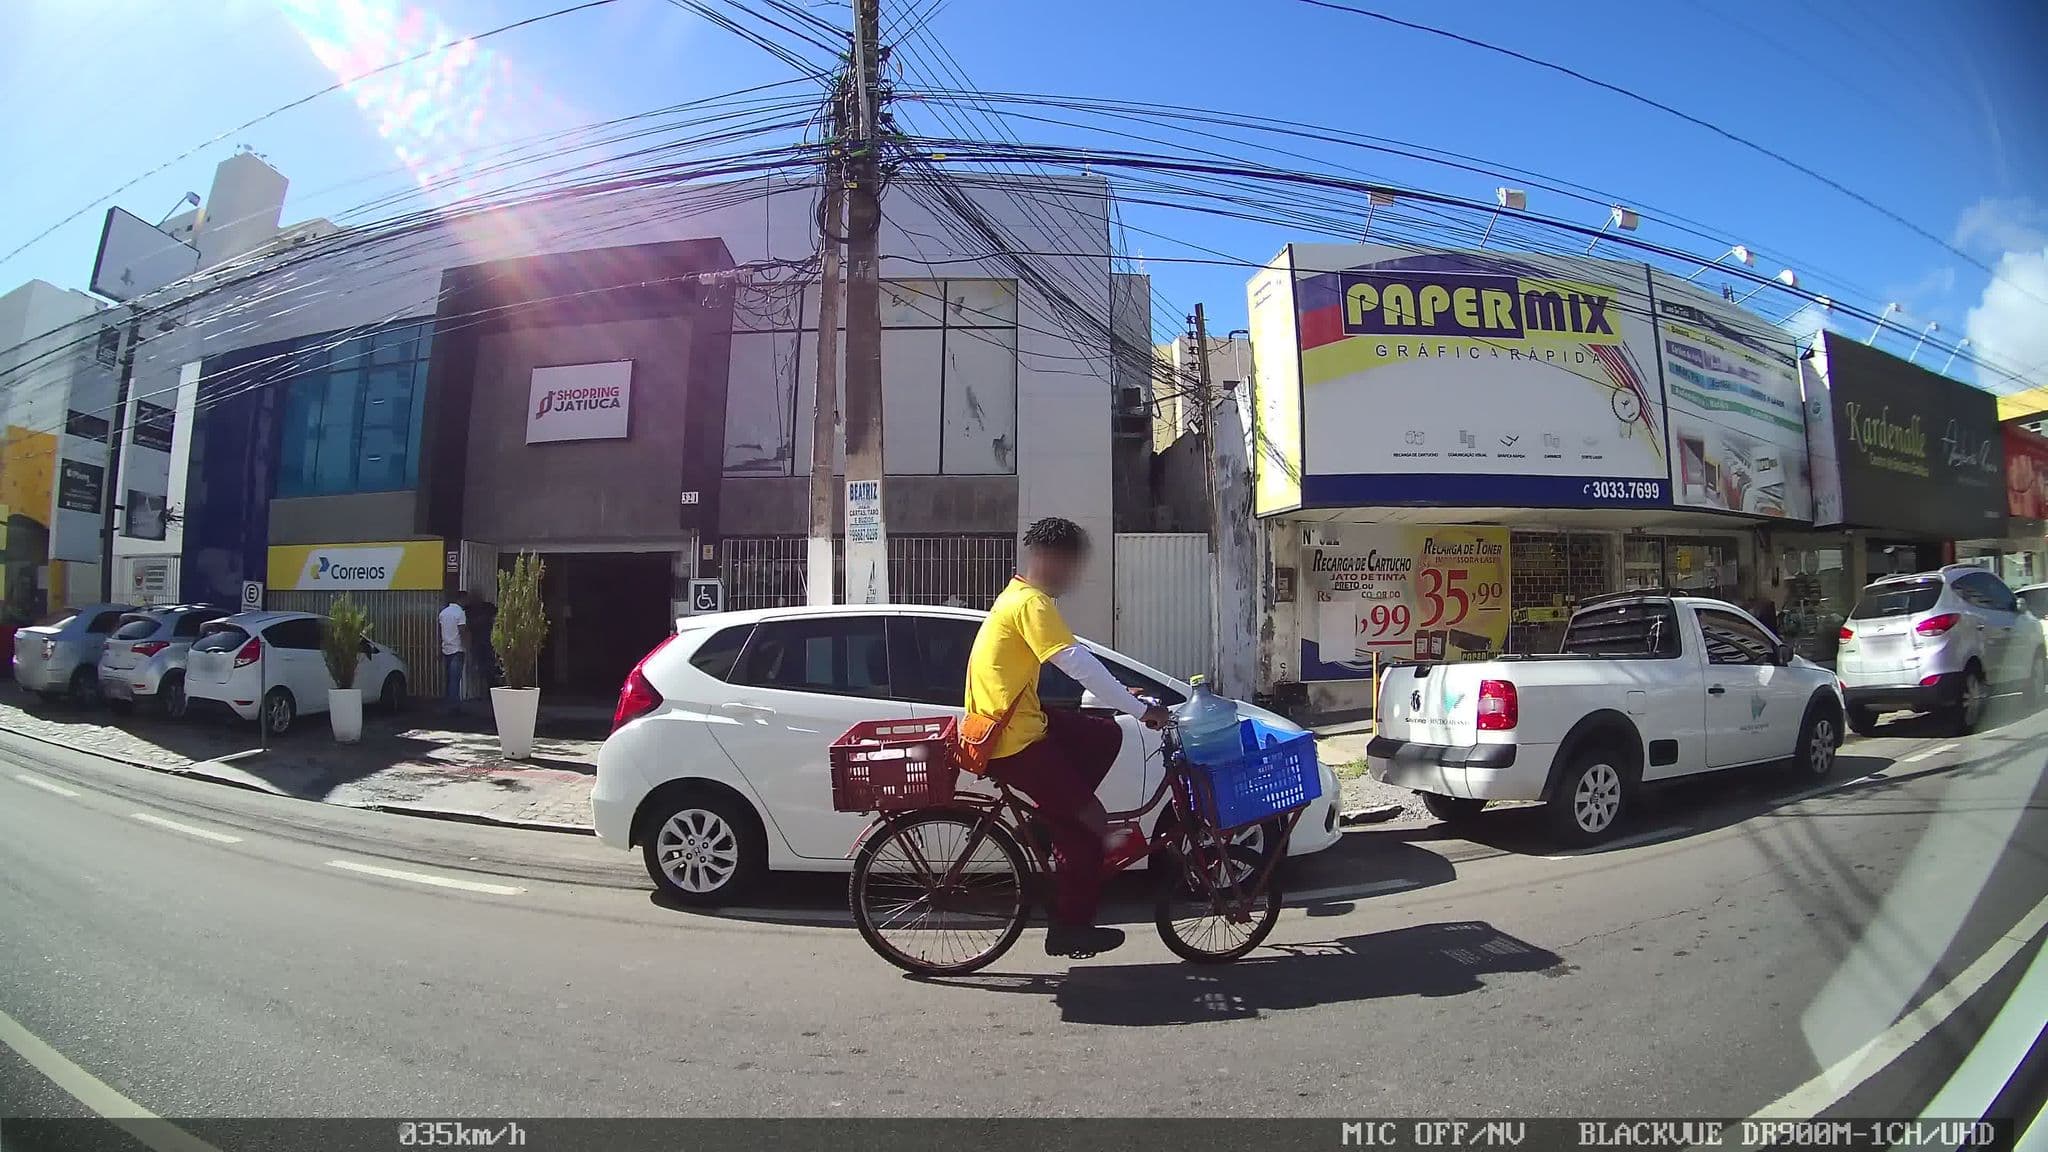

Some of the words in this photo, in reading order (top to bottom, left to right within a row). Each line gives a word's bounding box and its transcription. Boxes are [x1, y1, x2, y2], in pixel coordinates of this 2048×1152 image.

[1376, 342, 1499, 359] GRÁFICA
[1511, 346, 1601, 363] RÁPIDA
[557, 386, 620, 401] SHOPPING
[554, 396, 621, 412] JATIÚCA
[850, 482, 877, 500] BEATRIZ
[1592, 481, 1659, 498] 3033.7699
[1424, 538, 1462, 555] RECARGA
[1464, 544, 1475, 555] DE
[1476, 538, 1502, 555] TONER
[1313, 549, 1354, 572] RECARGA
[1355, 558, 1367, 572] DE
[1368, 549, 1412, 572] CARTUCHO
[331, 564, 385, 580] Correios
[1330, 573, 1358, 581] JATO
[1360, 573, 1375, 581] DE
[1376, 573, 1407, 581] TINTA
[1334, 581, 1360, 590] PRETO
